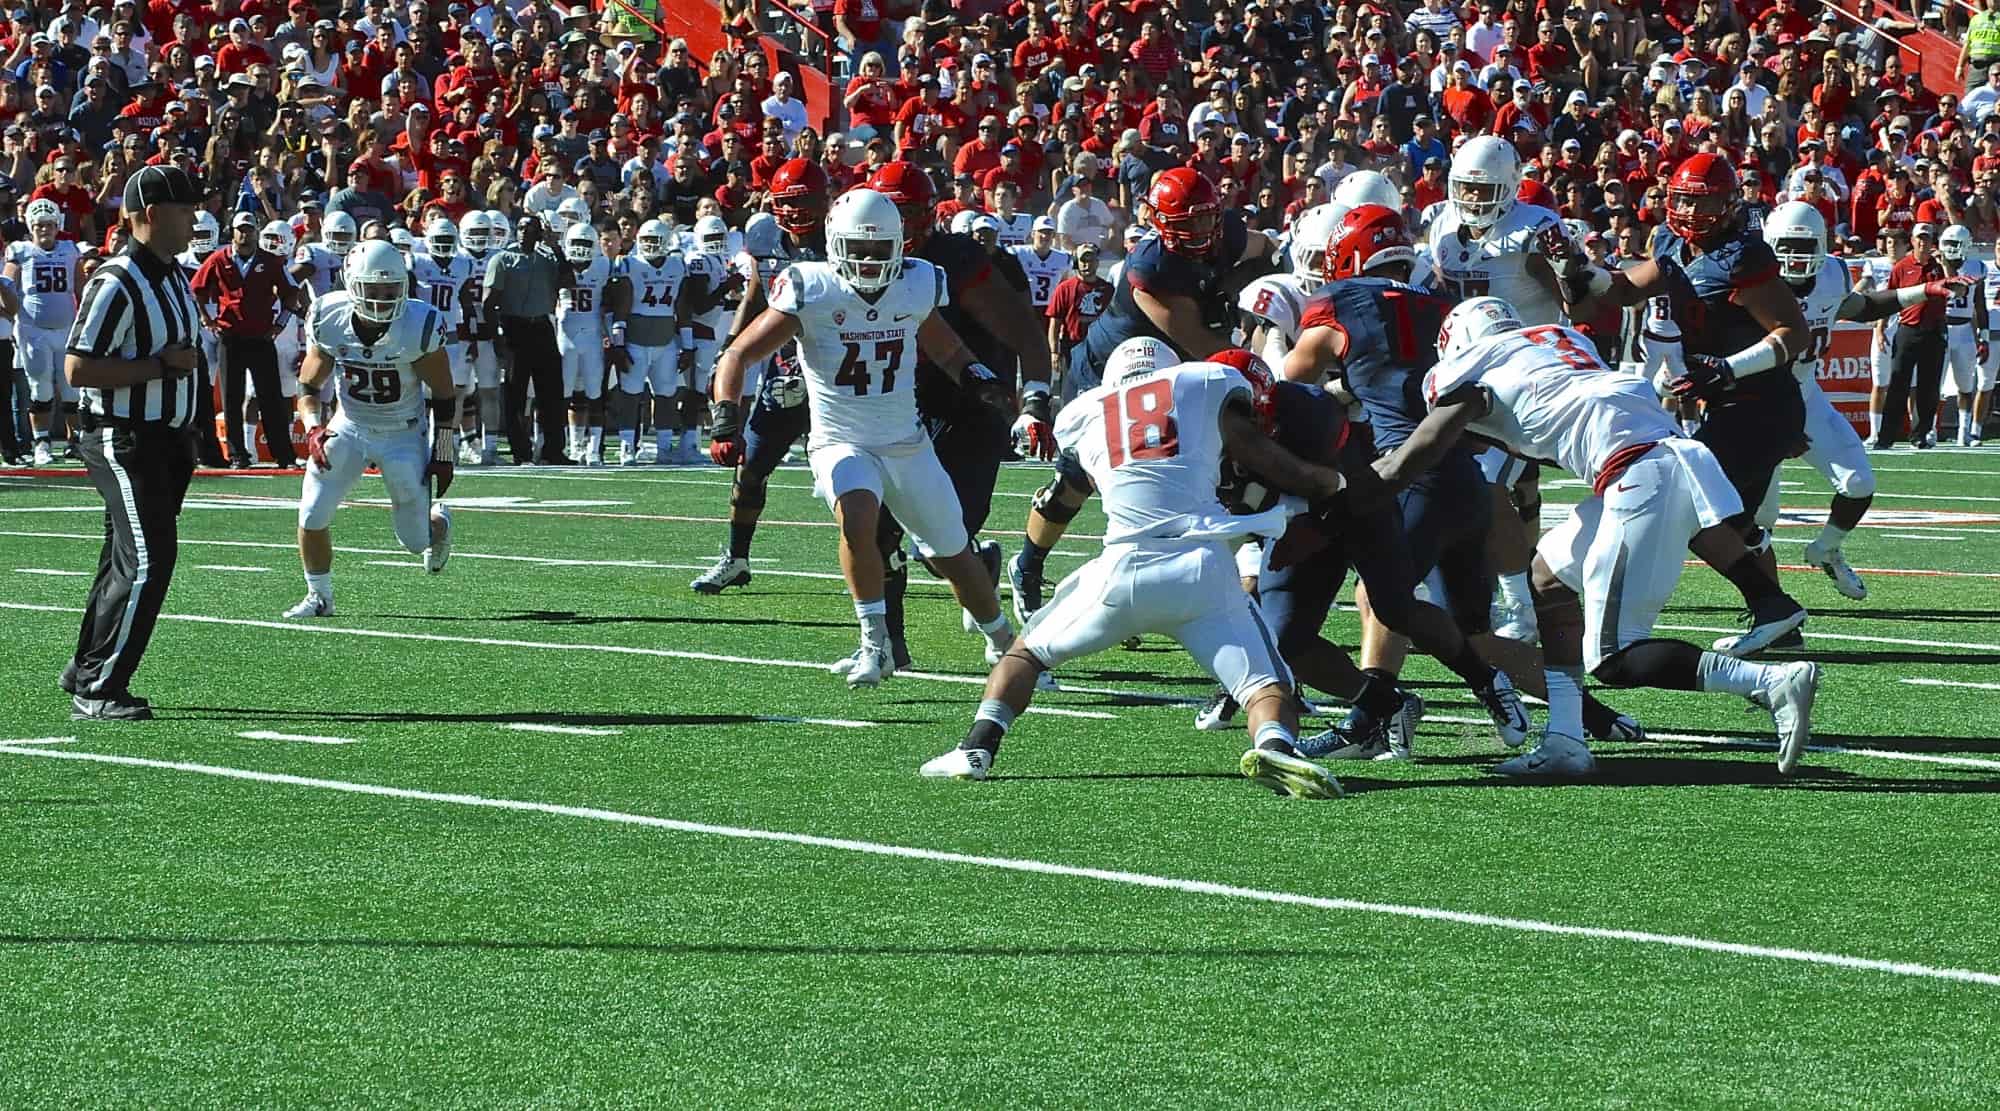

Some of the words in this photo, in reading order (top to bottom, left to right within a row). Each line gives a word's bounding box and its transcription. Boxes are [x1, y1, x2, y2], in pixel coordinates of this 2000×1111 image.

[1162, 123, 1178, 135] GO
[36, 266, 67, 293] 58
[1036, 276, 1050, 301] 3
[432, 284, 454, 312] 10
[641, 285, 673, 308] 44
[1252, 288, 1275, 315] 8
[840, 331, 885, 341] WASHINGTON
[886, 328, 906, 337] STATE
[834, 338, 905, 397] 47
[343, 364, 401, 405] 29
[1101, 378, 1180, 470] 18
